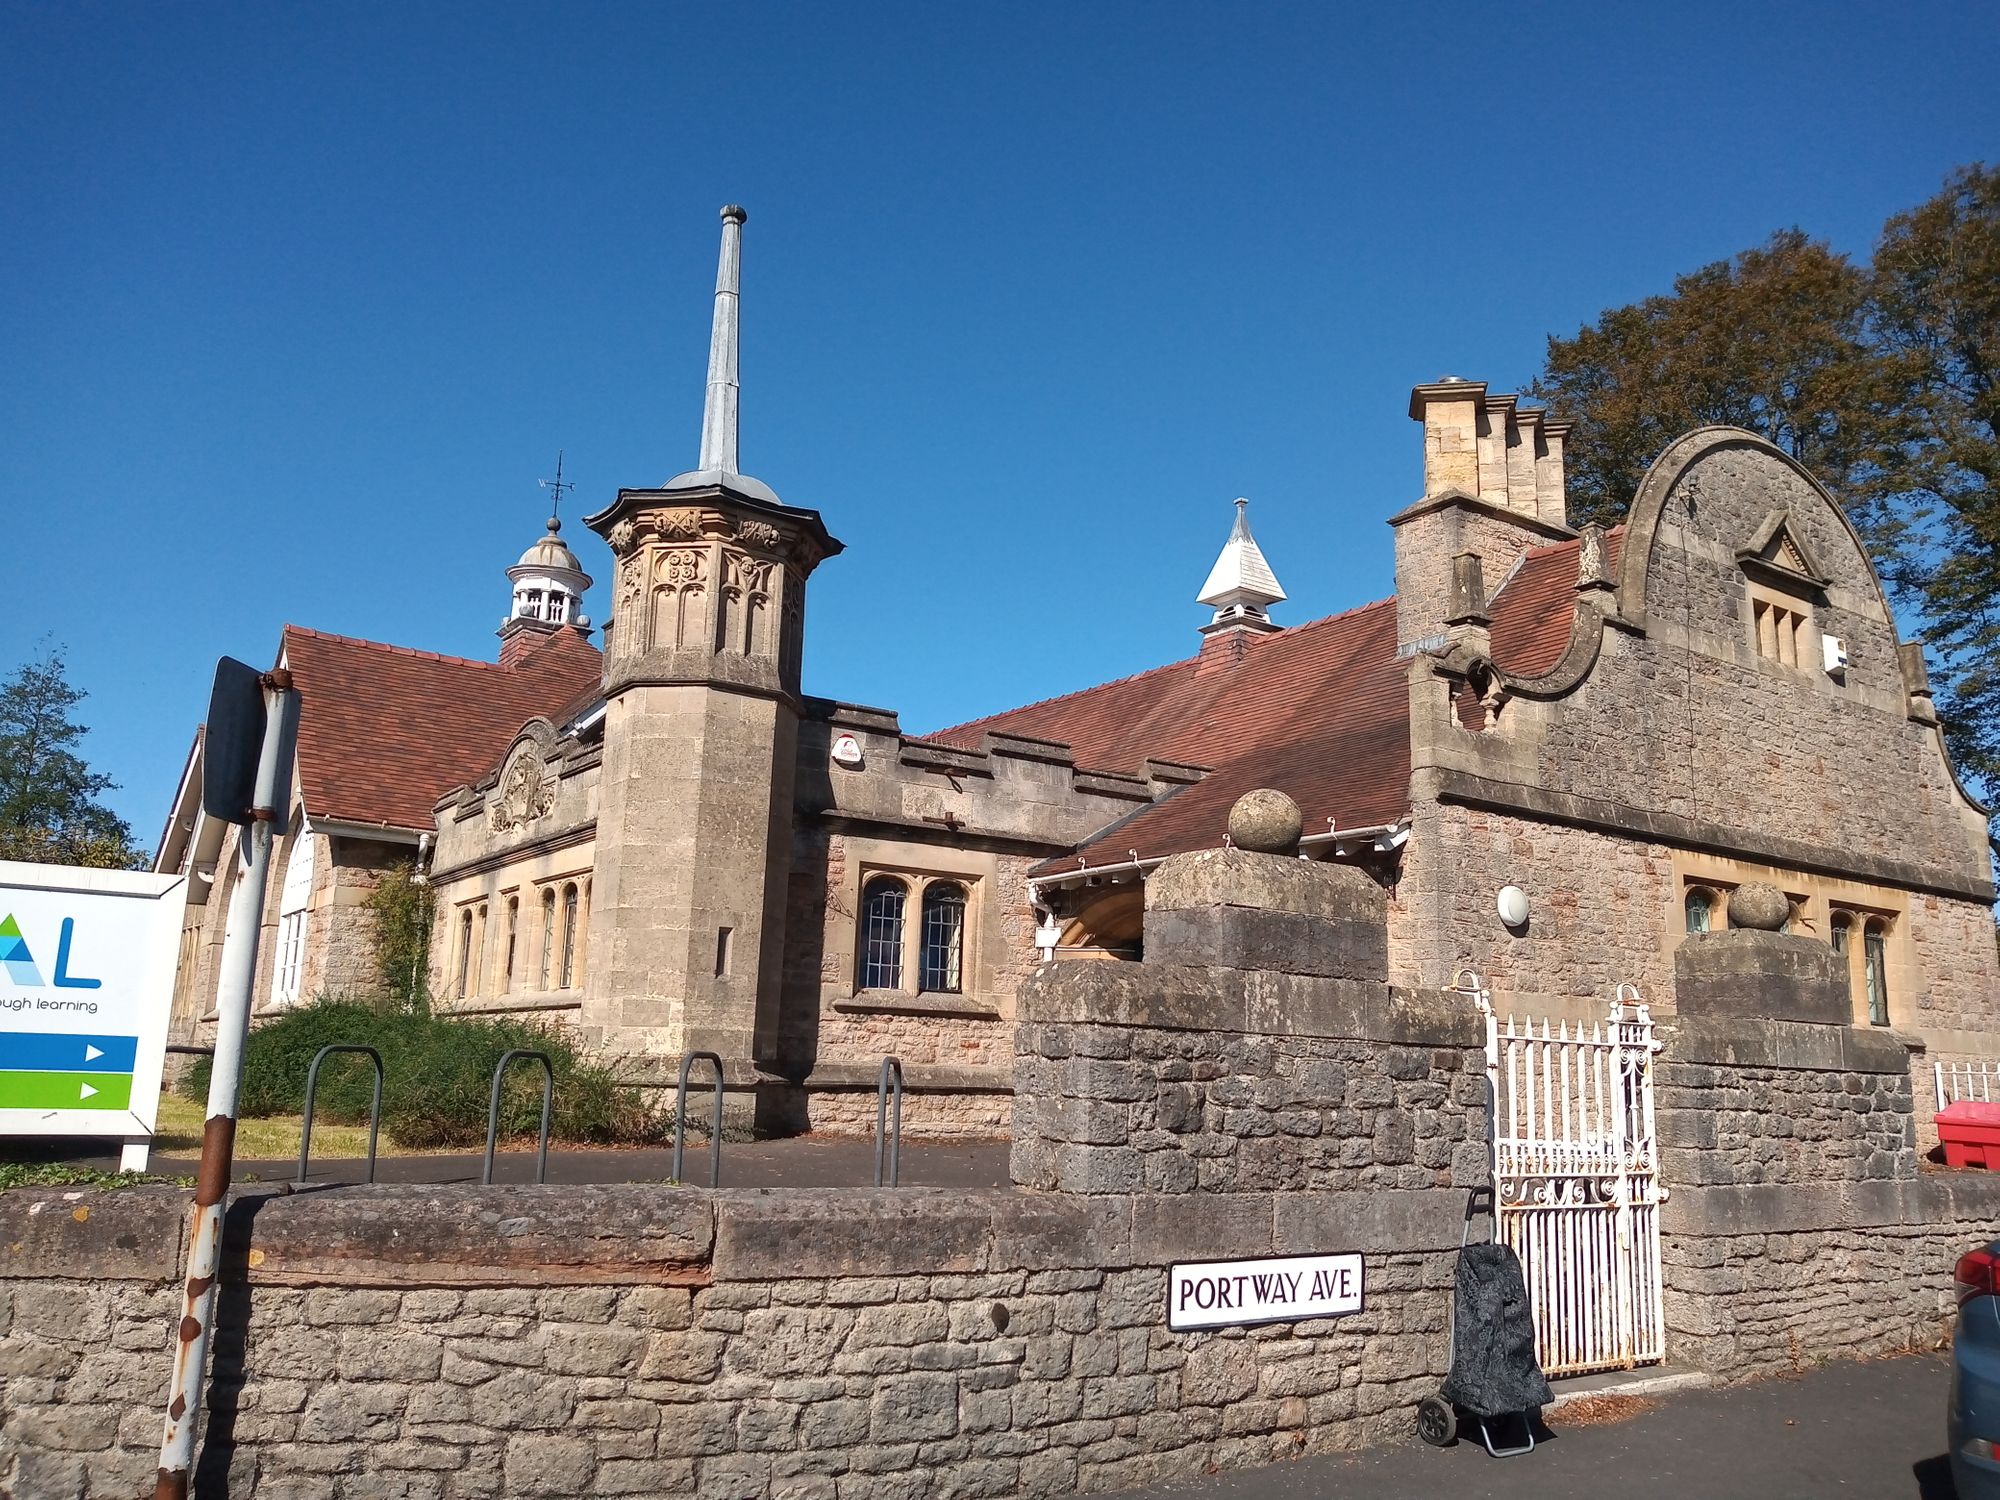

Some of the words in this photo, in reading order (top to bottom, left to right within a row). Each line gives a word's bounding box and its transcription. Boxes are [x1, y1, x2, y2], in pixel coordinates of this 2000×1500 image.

[0, 997, 31, 1011] ugh
[36, 998, 98, 1014] learning
[1179, 1271, 1303, 1311] PORTWAY
[1309, 1268, 1357, 1301] AVE.
